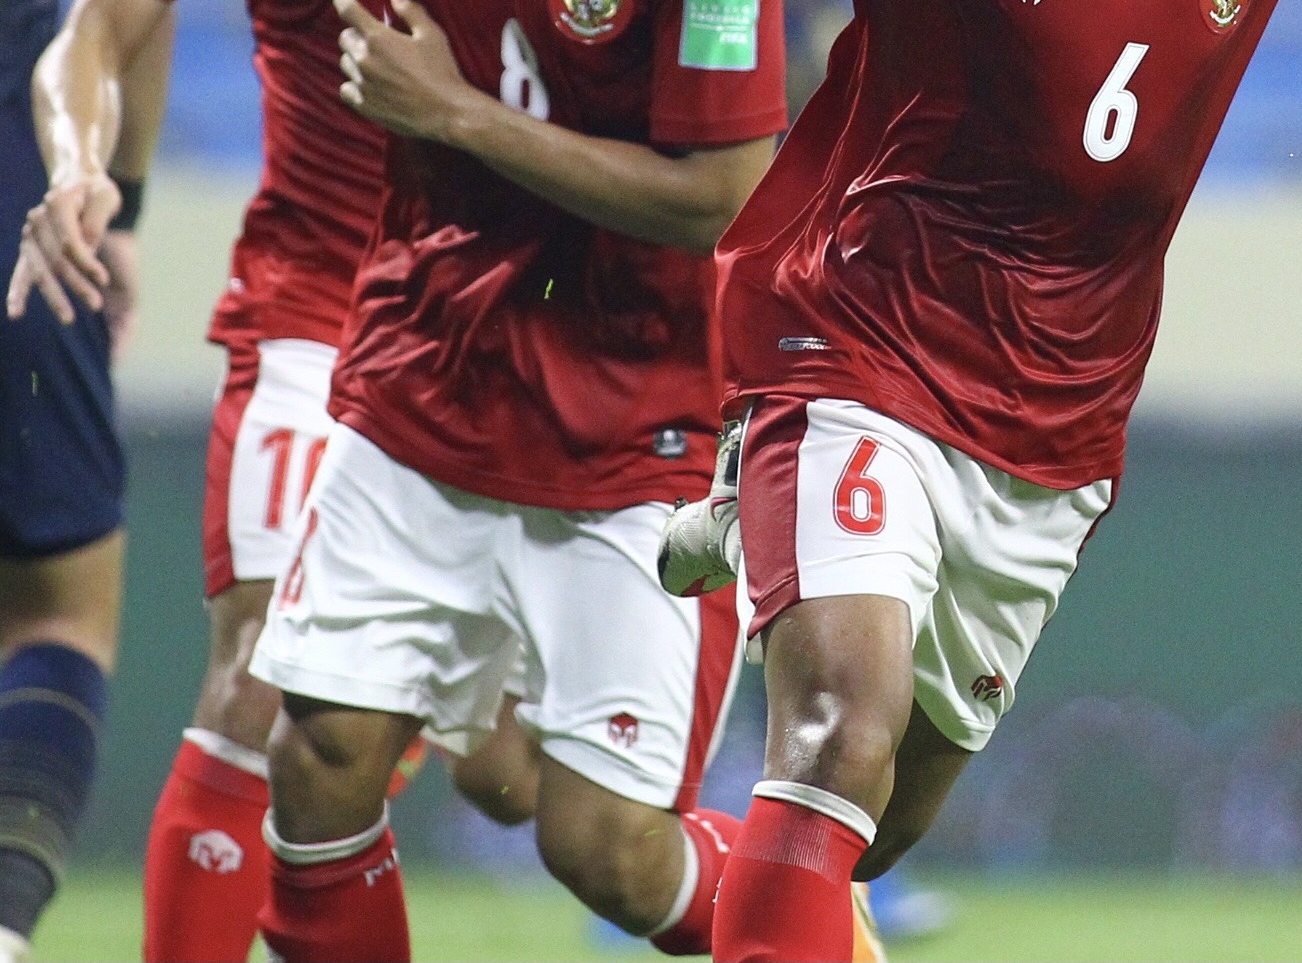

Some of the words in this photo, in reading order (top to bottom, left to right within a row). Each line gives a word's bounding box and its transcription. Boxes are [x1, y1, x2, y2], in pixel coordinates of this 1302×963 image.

[500, 17, 549, 123] 8
[1082, 41, 1151, 163] 6
[833, 434, 887, 536] 6
